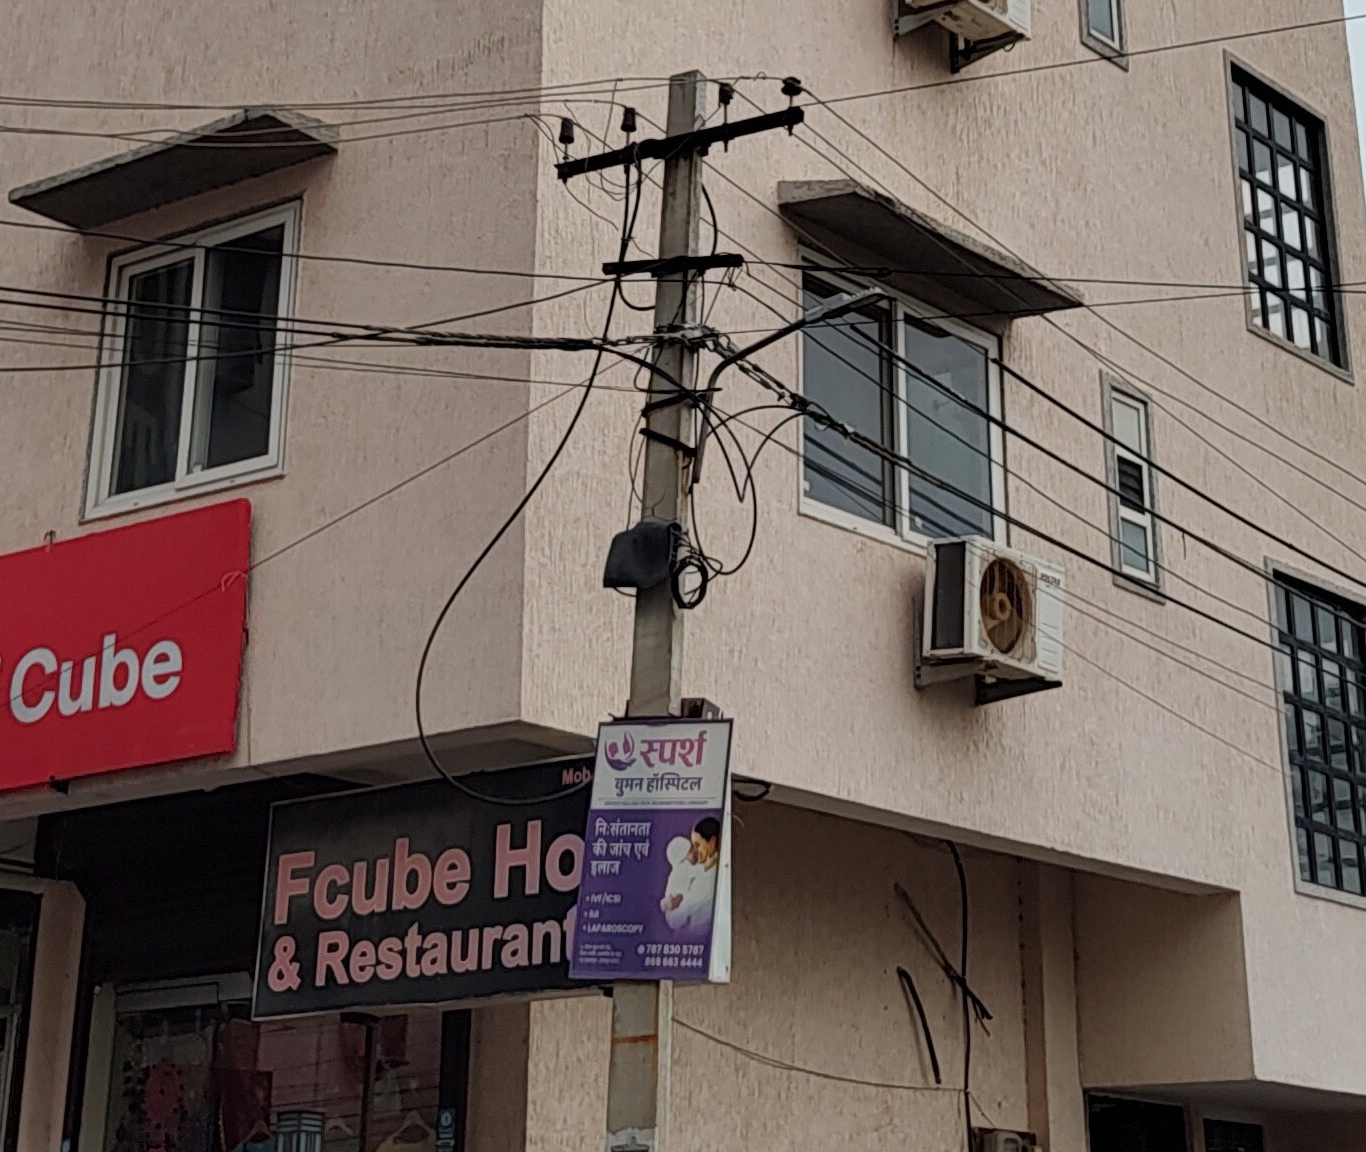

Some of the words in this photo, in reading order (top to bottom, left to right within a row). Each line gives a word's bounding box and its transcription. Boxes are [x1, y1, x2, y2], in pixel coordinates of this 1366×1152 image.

[639, 730, 708, 768] स्पर्श
[615, 776, 643, 797] वुमन
[646, 771, 703, 793] हॉस्पिटल
[592, 837, 607, 857] की
[609, 838, 632, 857] जांच
[634, 839, 650, 859] एवं
[273, 837, 472, 925] Fcube
[590, 859, 621, 877] इलाज
[587, 922, 644, 934] LAPAROSCOPY
[267, 935, 302, 993] &
